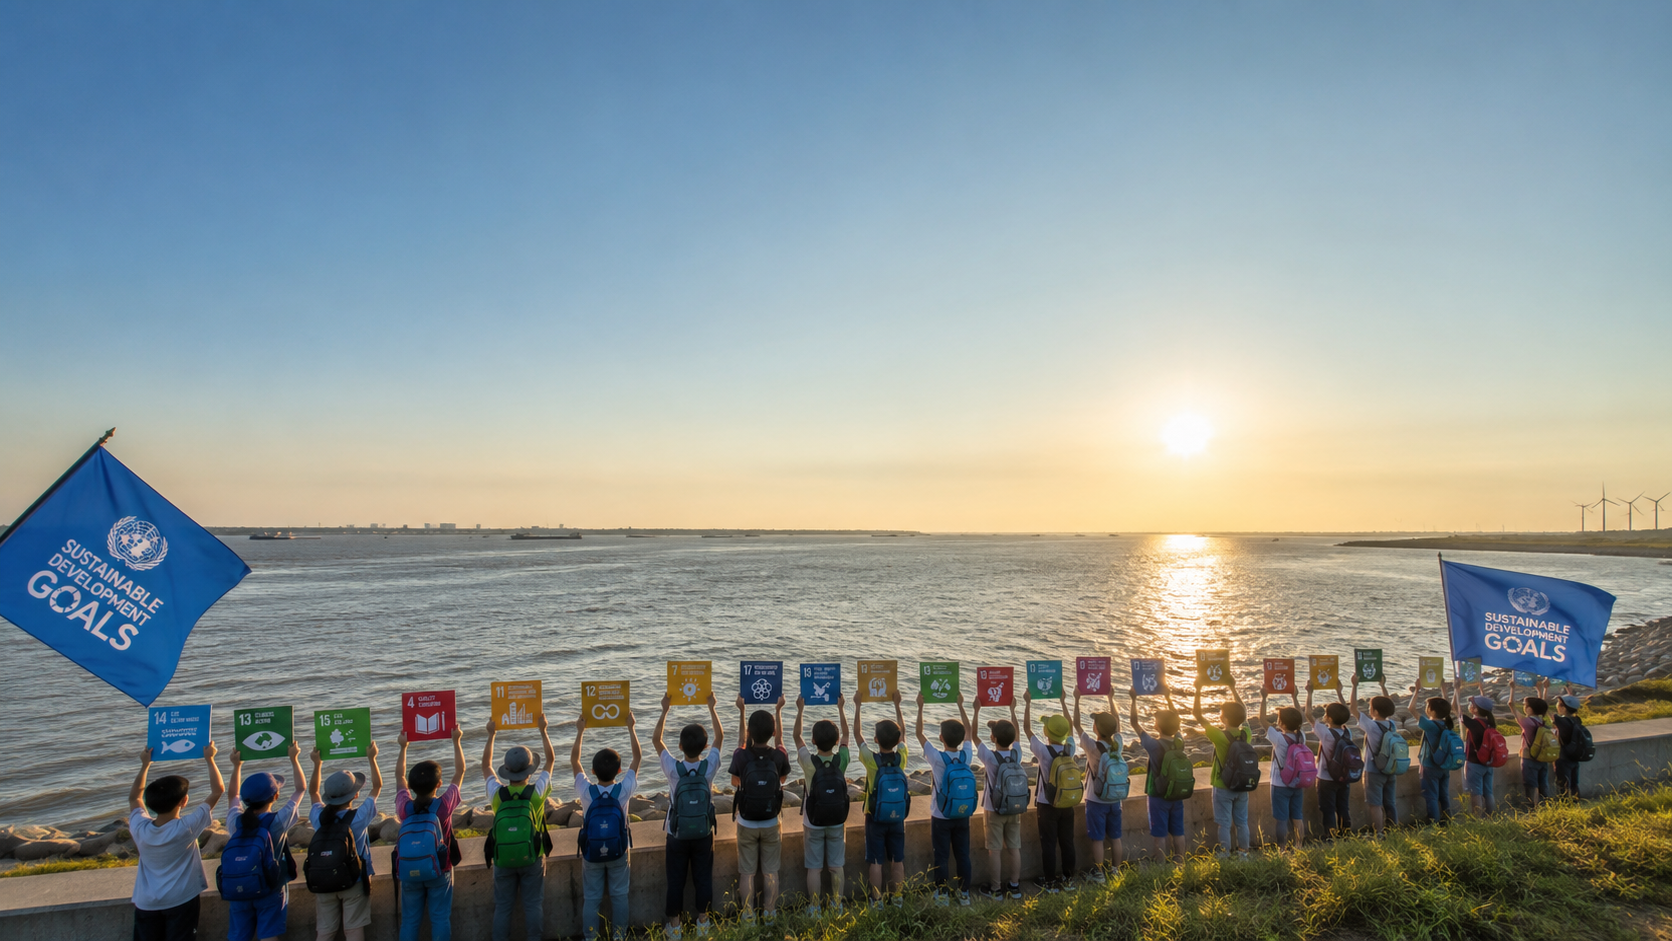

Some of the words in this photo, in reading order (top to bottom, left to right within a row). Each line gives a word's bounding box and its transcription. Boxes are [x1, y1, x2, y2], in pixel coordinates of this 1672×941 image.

[61, 539, 164, 614] SUSTAINABLE
[47, 553, 152, 627] DEVELOPMENT
[27, 570, 140, 651] GOALS
[1485, 612, 1571, 636] SUSTAINABLE
[1484, 633, 1567, 663] GOALS
[671, 664, 678, 676] 7
[743, 664, 752, 676] 17
[496, 686, 504, 698] 11
[585, 685, 596, 697] 12
[407, 696, 415, 708] 4
[154, 711, 167, 725] 14
[239, 713, 252, 726] 13
[319, 714, 331, 726] 15
